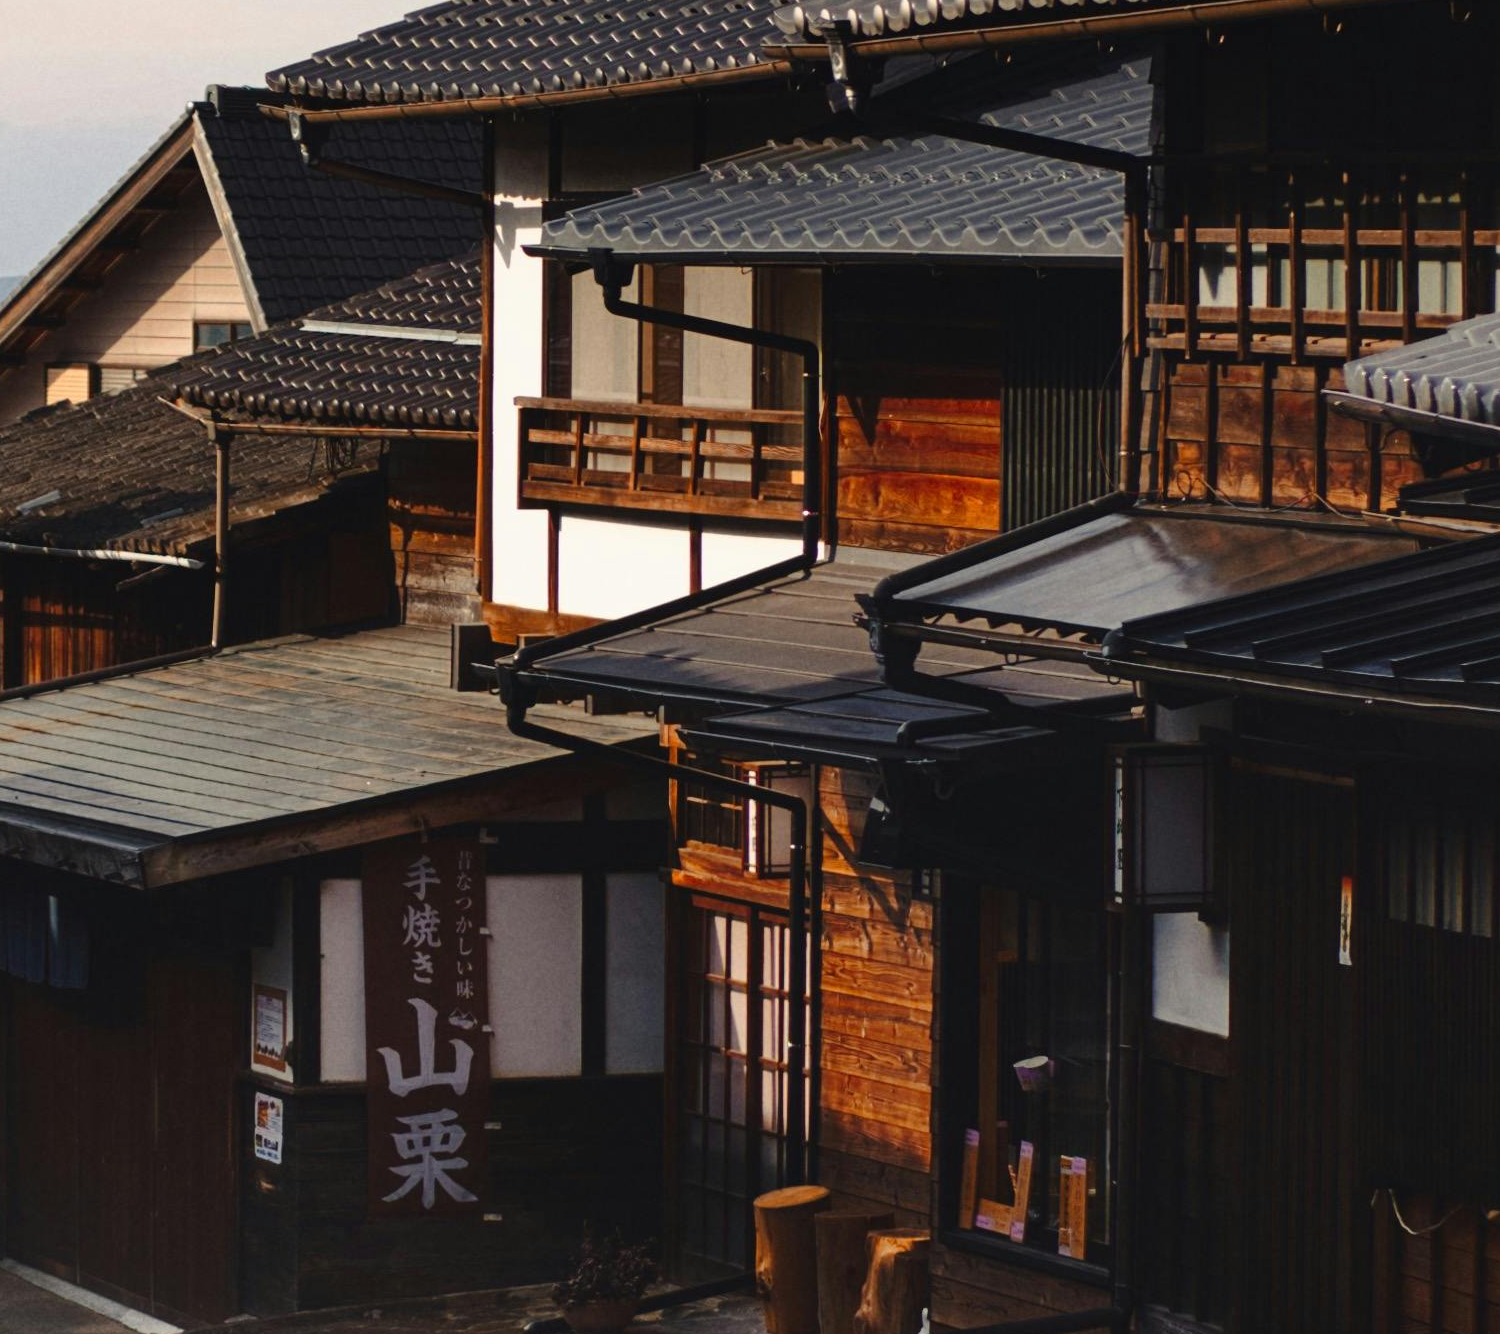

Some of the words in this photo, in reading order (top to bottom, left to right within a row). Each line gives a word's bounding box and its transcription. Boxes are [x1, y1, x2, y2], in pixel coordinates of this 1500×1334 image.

[454, 850, 475, 1000] 昔なつかしい味
